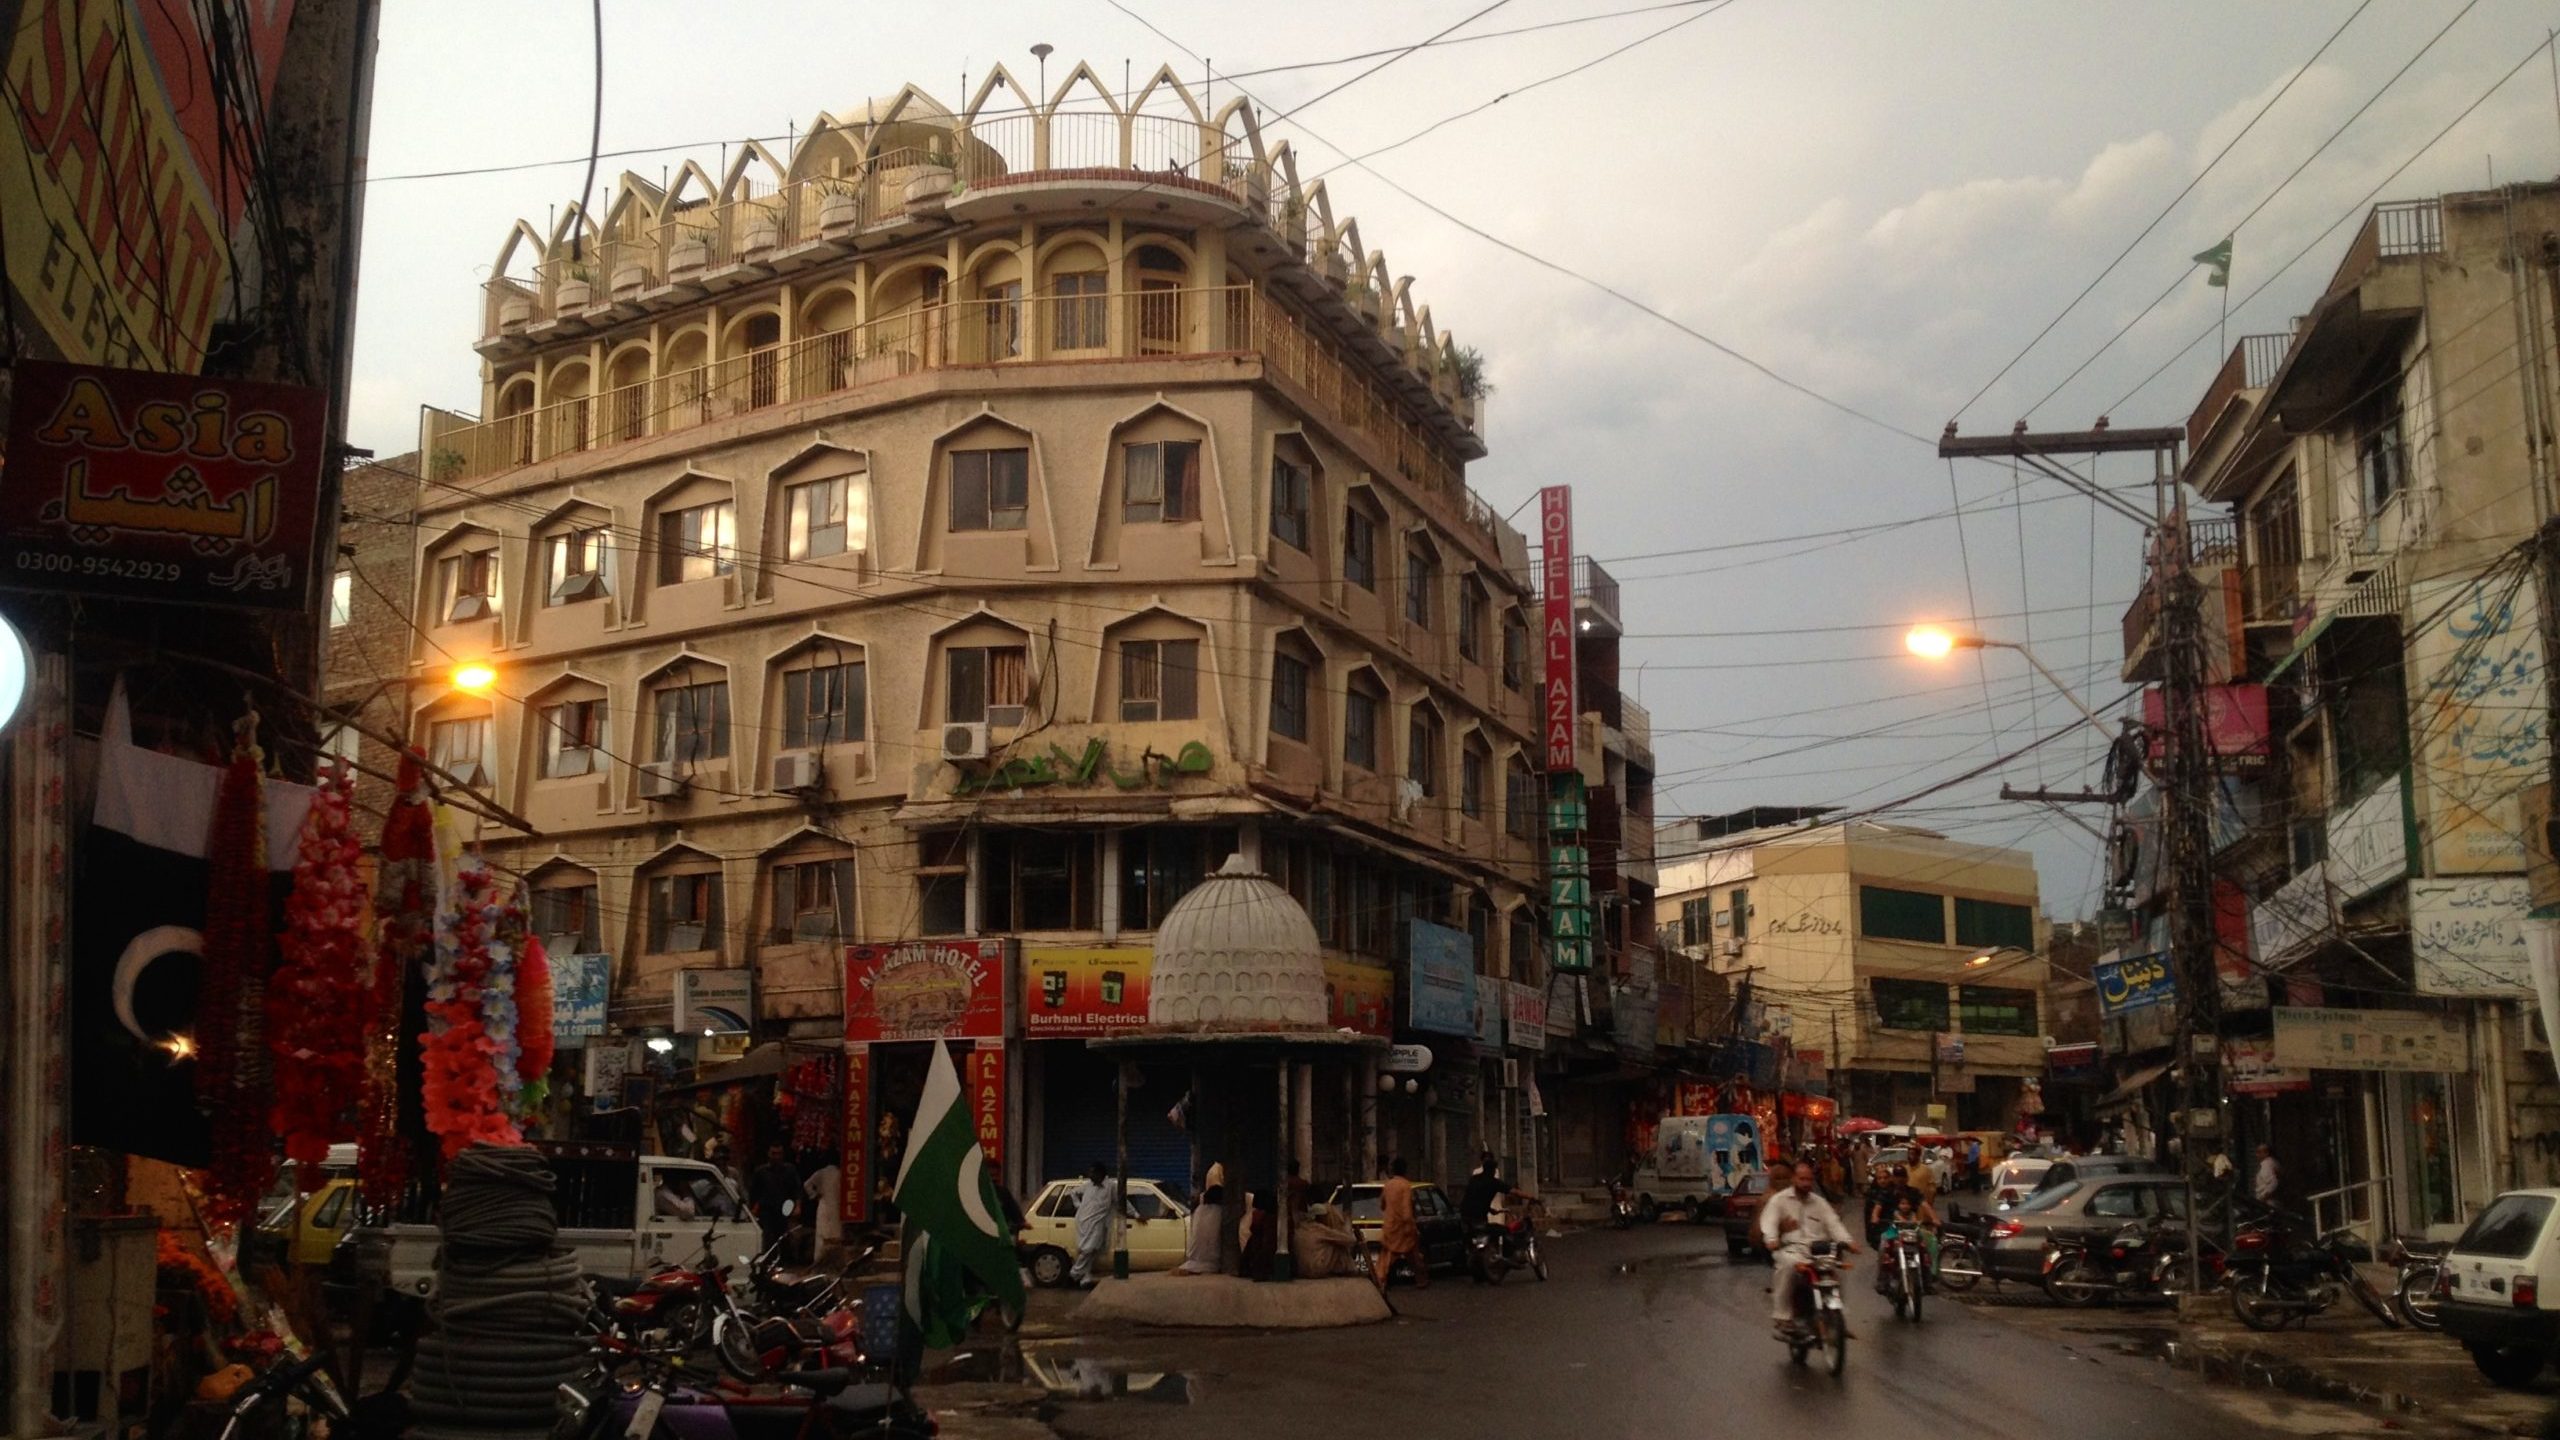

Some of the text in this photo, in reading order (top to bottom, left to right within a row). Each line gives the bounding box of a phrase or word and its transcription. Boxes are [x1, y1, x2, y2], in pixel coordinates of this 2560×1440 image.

[37, 377, 295, 464] Asia
[15, 550, 183, 582] 0300-9542929
[1545, 491, 1573, 768] HOTEL AL AZAM
[1555, 849, 1577, 966] AZAM
[858, 965, 876, 992] AL
[882, 944, 927, 971] AZAM
[933, 945, 988, 987] HOTEL
[1030, 1012, 1147, 1024] Burhani Electrics
[2313, 1009, 2363, 1024] Systems
[848, 1057, 862, 1084] AL
[982, 1052, 997, 1080] AL
[846, 1089, 862, 1143] AZAM
[980, 1085, 997, 1140] AZAM
[845, 1149, 861, 1217] HOTEL
